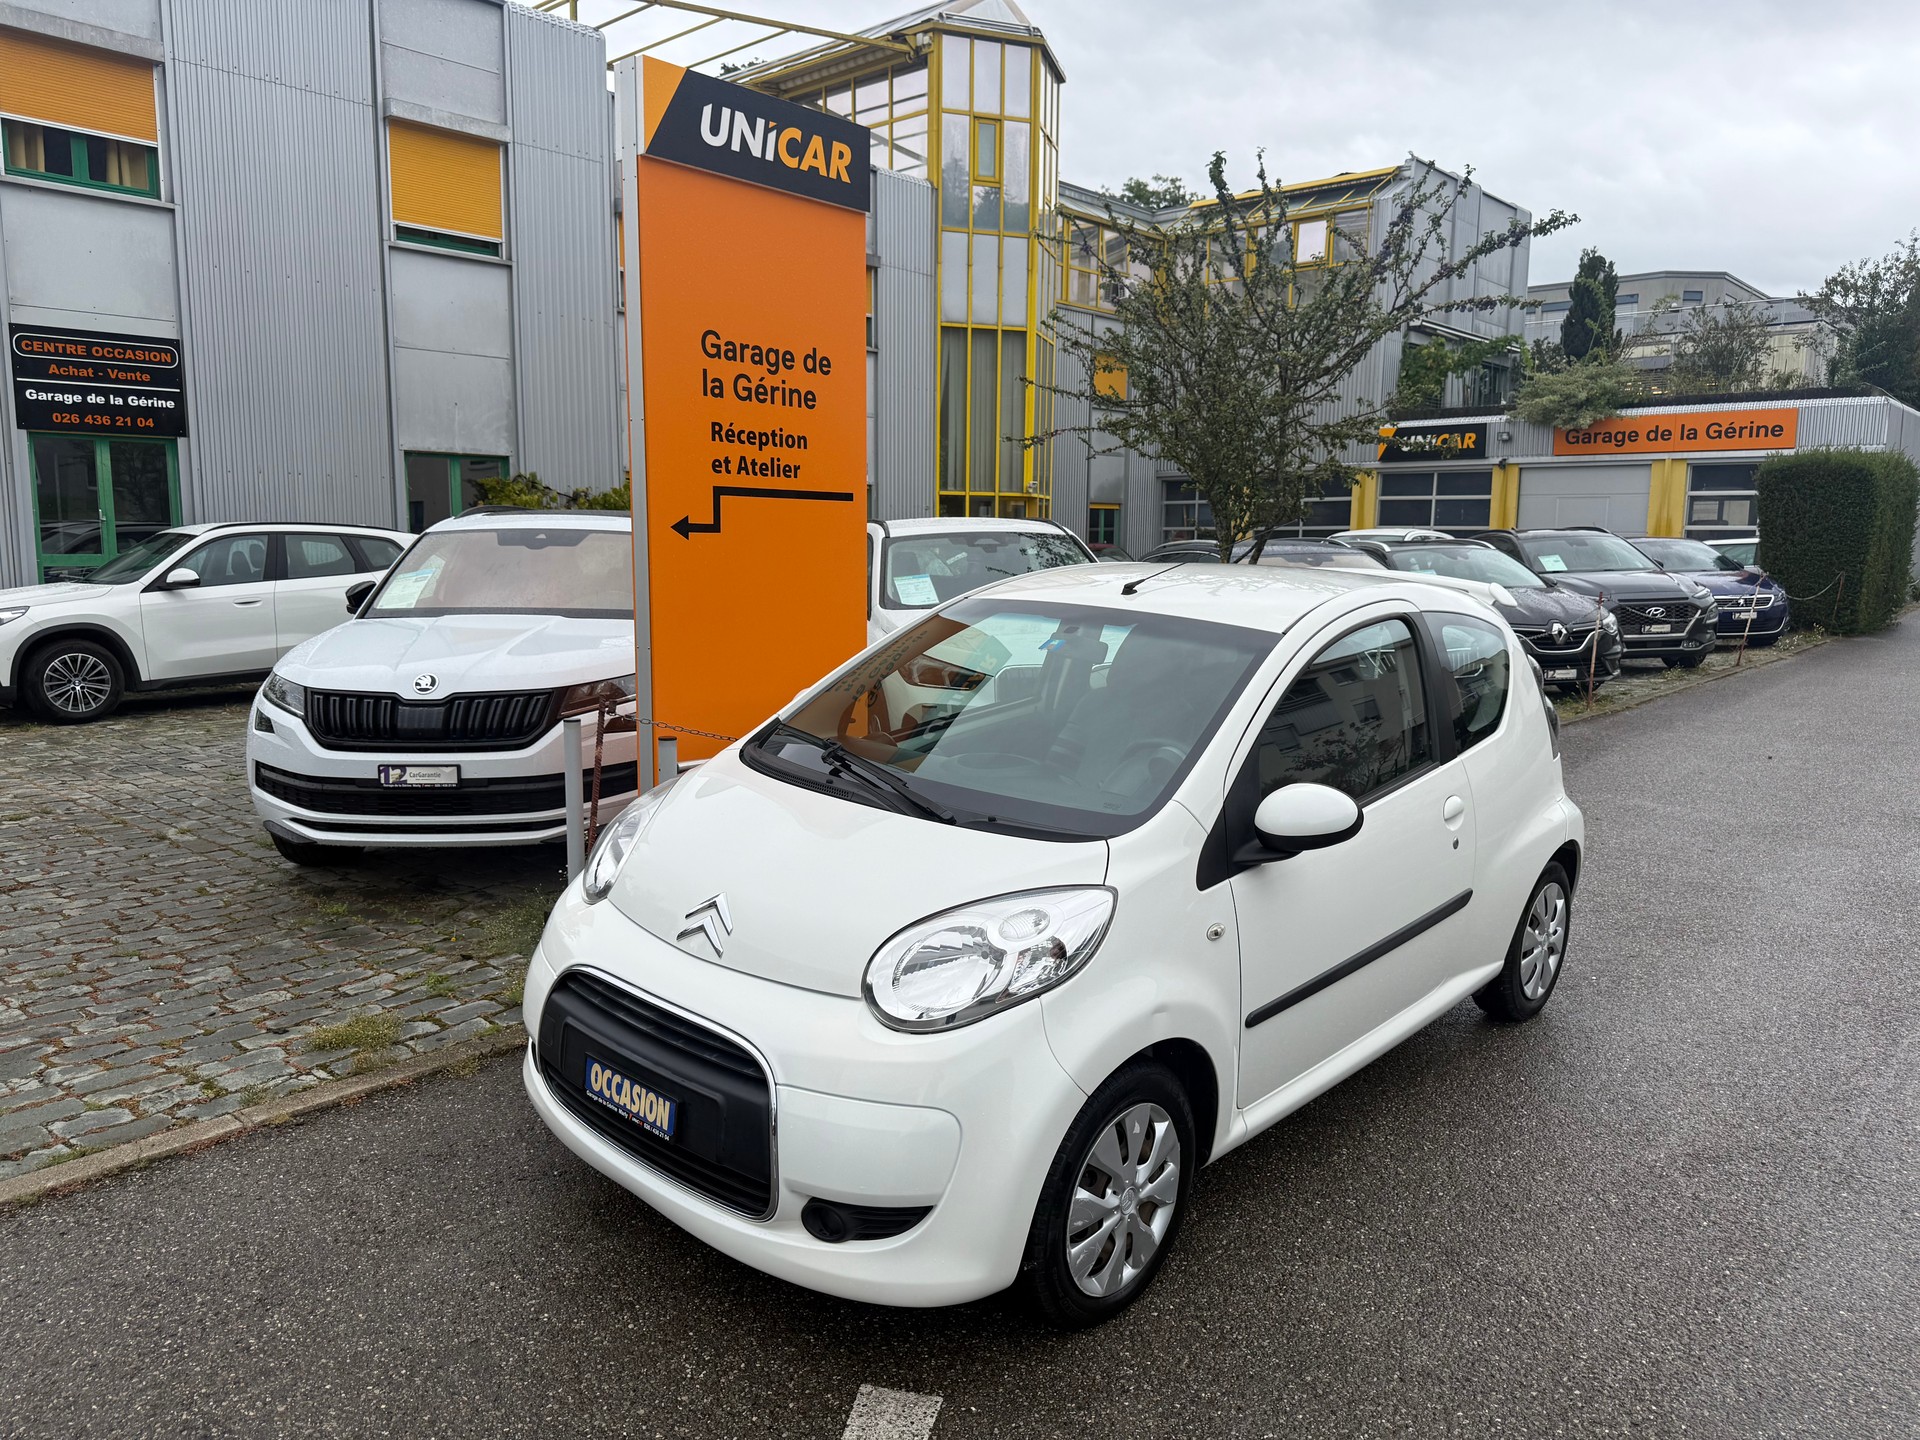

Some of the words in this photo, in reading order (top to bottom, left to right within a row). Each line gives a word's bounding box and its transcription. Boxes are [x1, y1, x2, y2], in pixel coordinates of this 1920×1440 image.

[21, 340, 87, 356] CENTRE
[91, 346, 172, 363] OCCASION
[701, 329, 795, 376] Garage
[803, 347, 832, 376] de
[48, 364, 94, 378] Achat
[107, 368, 151, 382] Vente
[25, 389, 82, 405] Garage
[86, 393, 106, 404] de
[110, 394, 123, 406] la
[127, 395, 175, 409] Gérine
[702, 368, 724, 399] la
[733, 373, 817, 410] Gérine
[52, 412, 80, 424] 026
[84, 414, 111, 426] 436
[115, 416, 132, 427] 21
[137, 417, 155, 428] 04
[711, 421, 808, 451] Réception
[1565, 428, 1639, 448] Garage
[1646, 425, 1672, 441] de
[1680, 424, 1698, 440] la
[1706, 420, 1784, 439] Gérine
[711, 456, 732, 474] et
[736, 455, 801, 479] Atelier
[409, 771, 441, 779] CarGarantie
[591, 1063, 670, 1131] OCCASION
